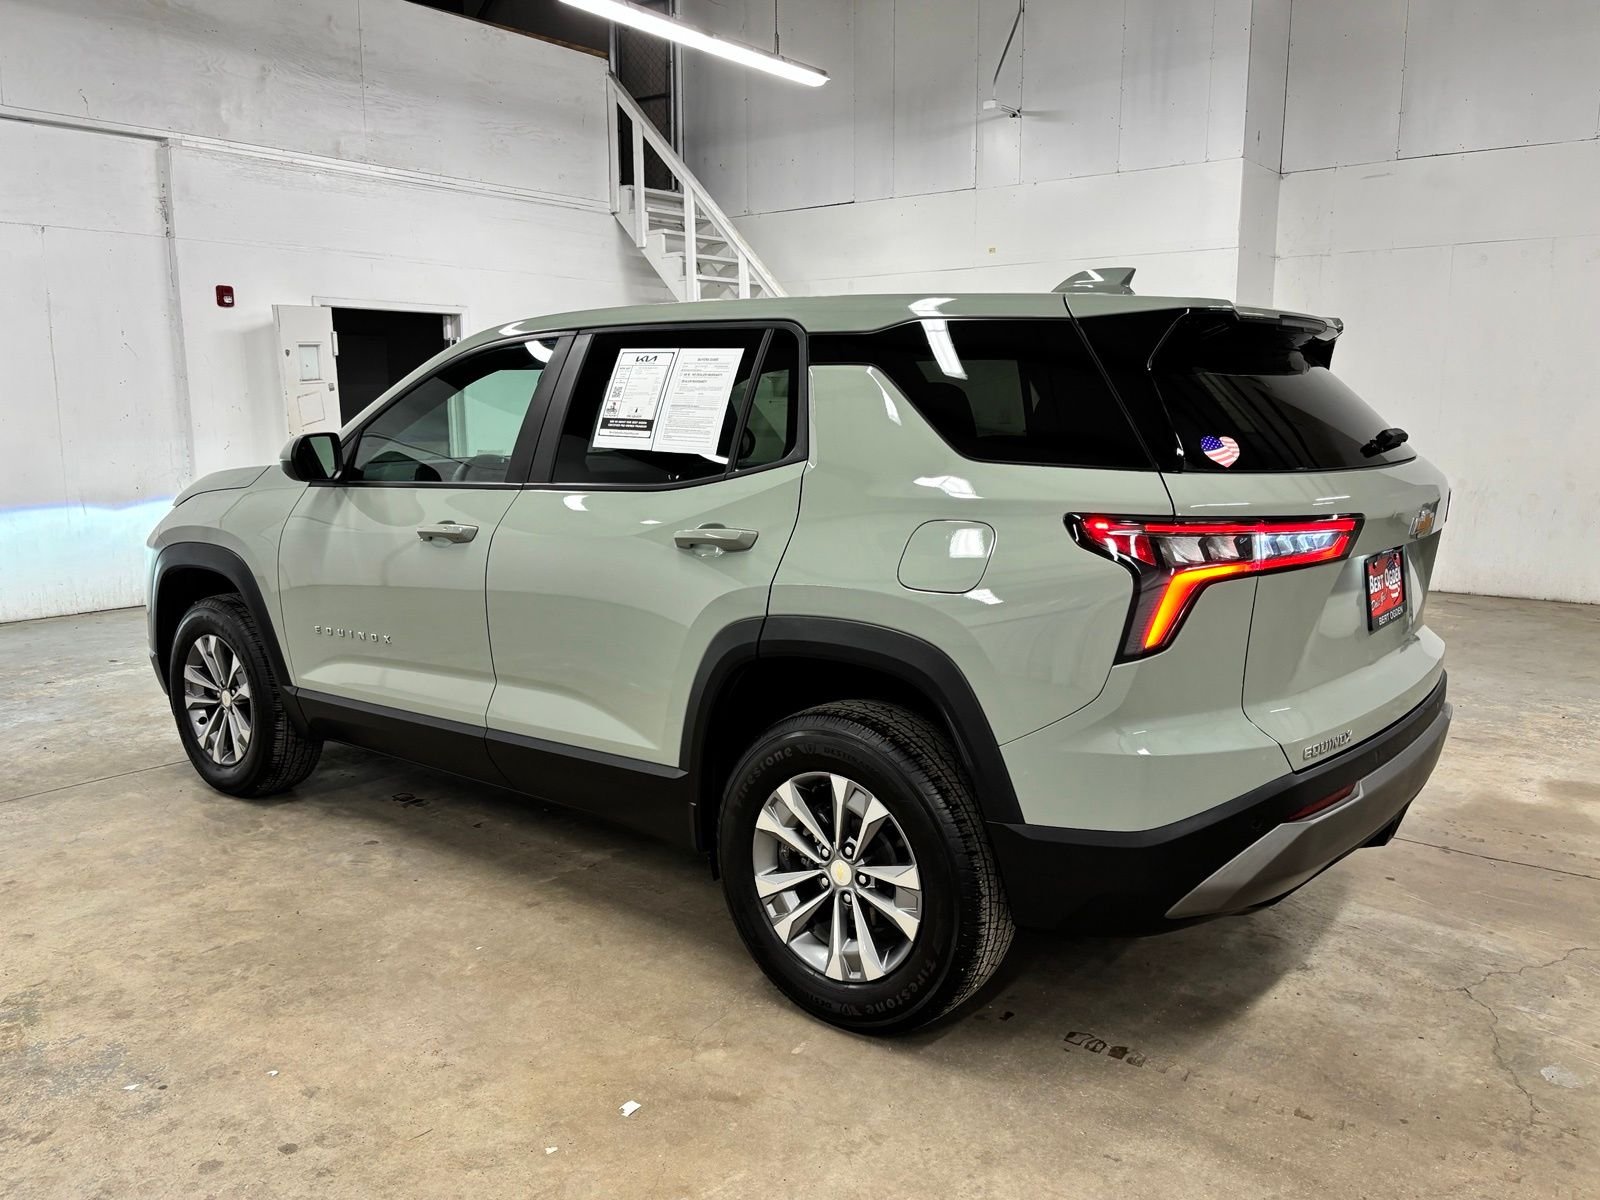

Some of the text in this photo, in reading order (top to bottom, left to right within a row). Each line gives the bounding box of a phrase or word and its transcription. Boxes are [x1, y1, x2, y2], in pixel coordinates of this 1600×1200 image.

[635, 355, 658, 363] KIA
[1368, 566, 1402, 595] BERT OGDEN
[1378, 606, 1404, 626] BERT OGDEN
[314, 625, 392, 645] EQUINOX
[1303, 729, 1353, 761] EQUINOX
